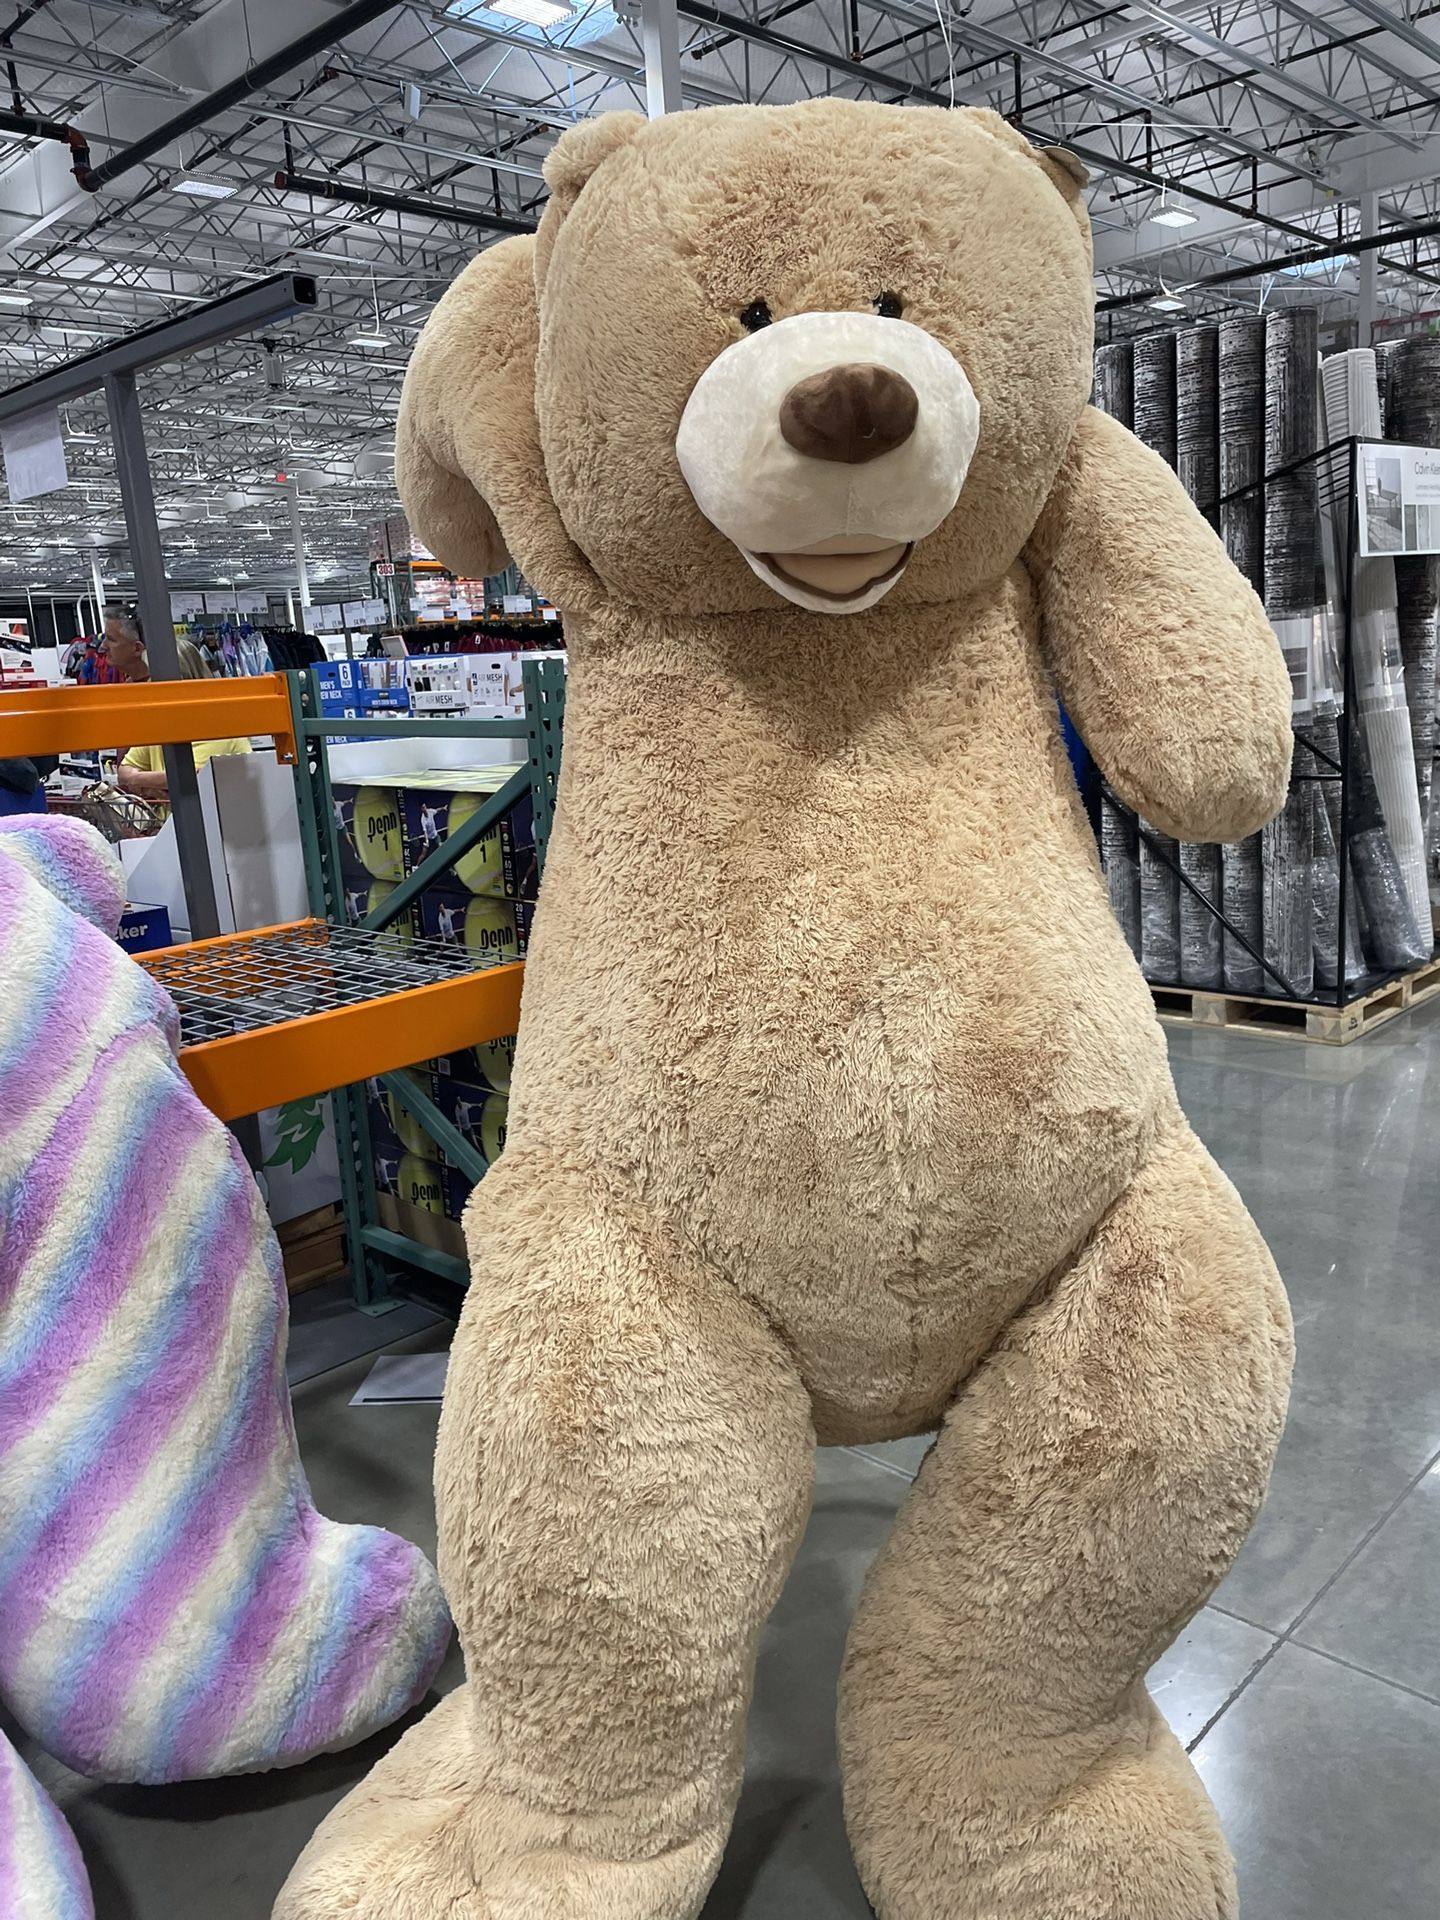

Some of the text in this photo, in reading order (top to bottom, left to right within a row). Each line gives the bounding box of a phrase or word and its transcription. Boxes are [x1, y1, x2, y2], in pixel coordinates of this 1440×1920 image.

[379, 565, 393, 575] 303
[342, 666, 348, 680] 6
[486, 673, 503, 681] MESH
[330, 690, 342, 699] NECK
[435, 695, 453, 704] MESH
[383, 834, 388, 851] 1
[480, 844, 486, 863] 1
